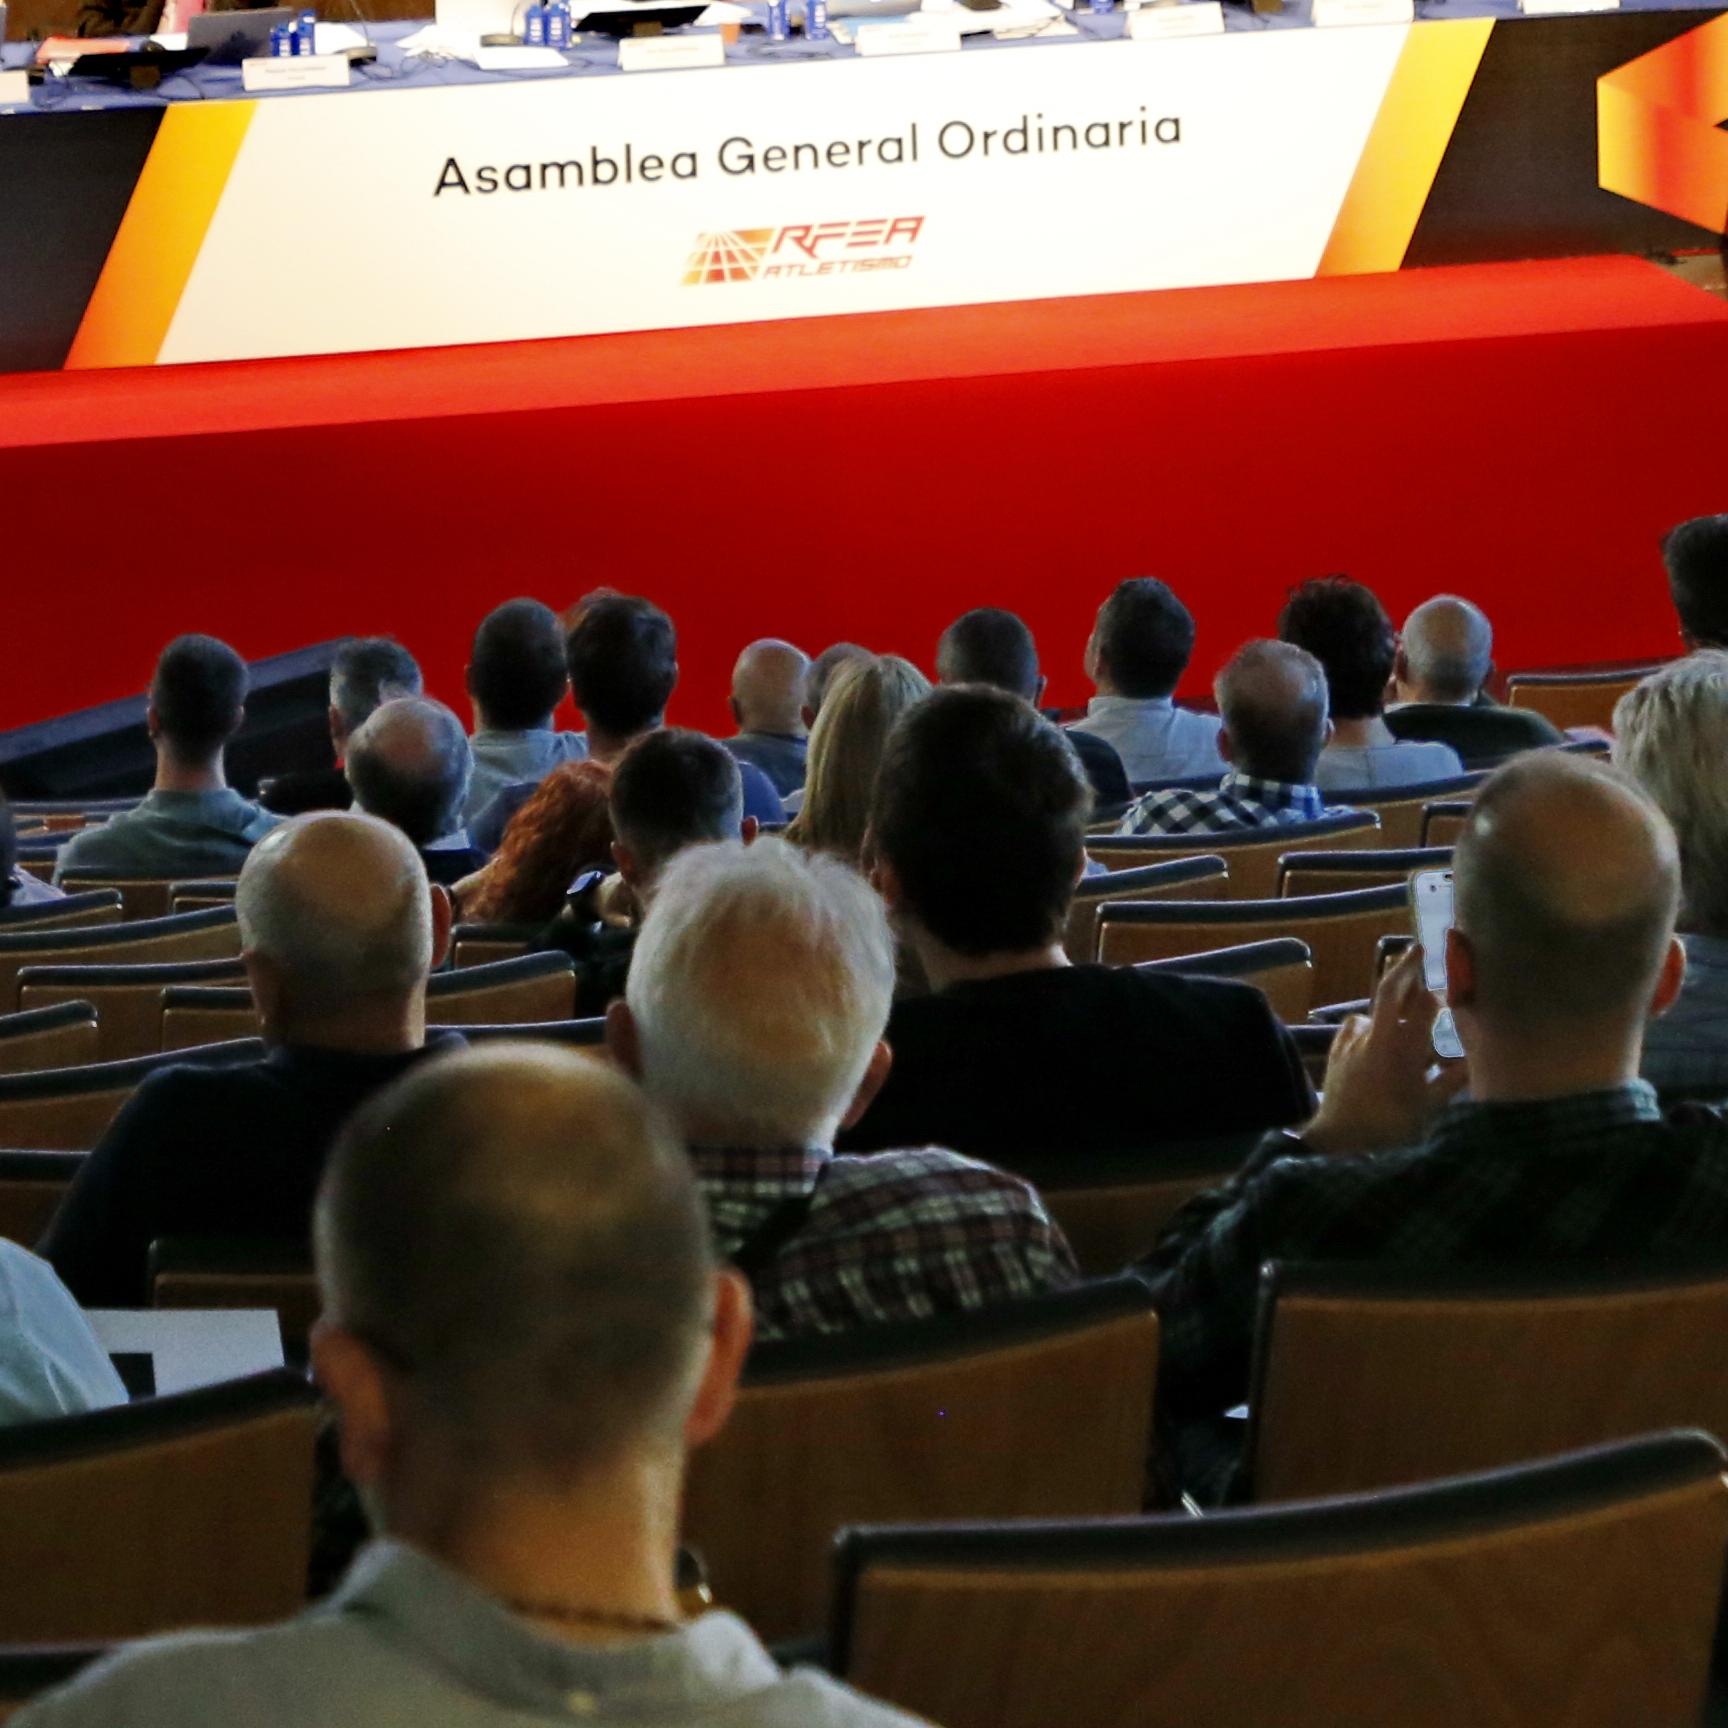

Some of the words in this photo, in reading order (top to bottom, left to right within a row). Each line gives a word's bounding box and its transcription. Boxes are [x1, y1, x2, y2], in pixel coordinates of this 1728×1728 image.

[432, 143, 699, 198] Asamblea
[717, 122, 918, 176] General
[938, 105, 1182, 160] Ordinaria
[771, 215, 926, 259] RFEA
[762, 255, 913, 280] ATLETISMO
